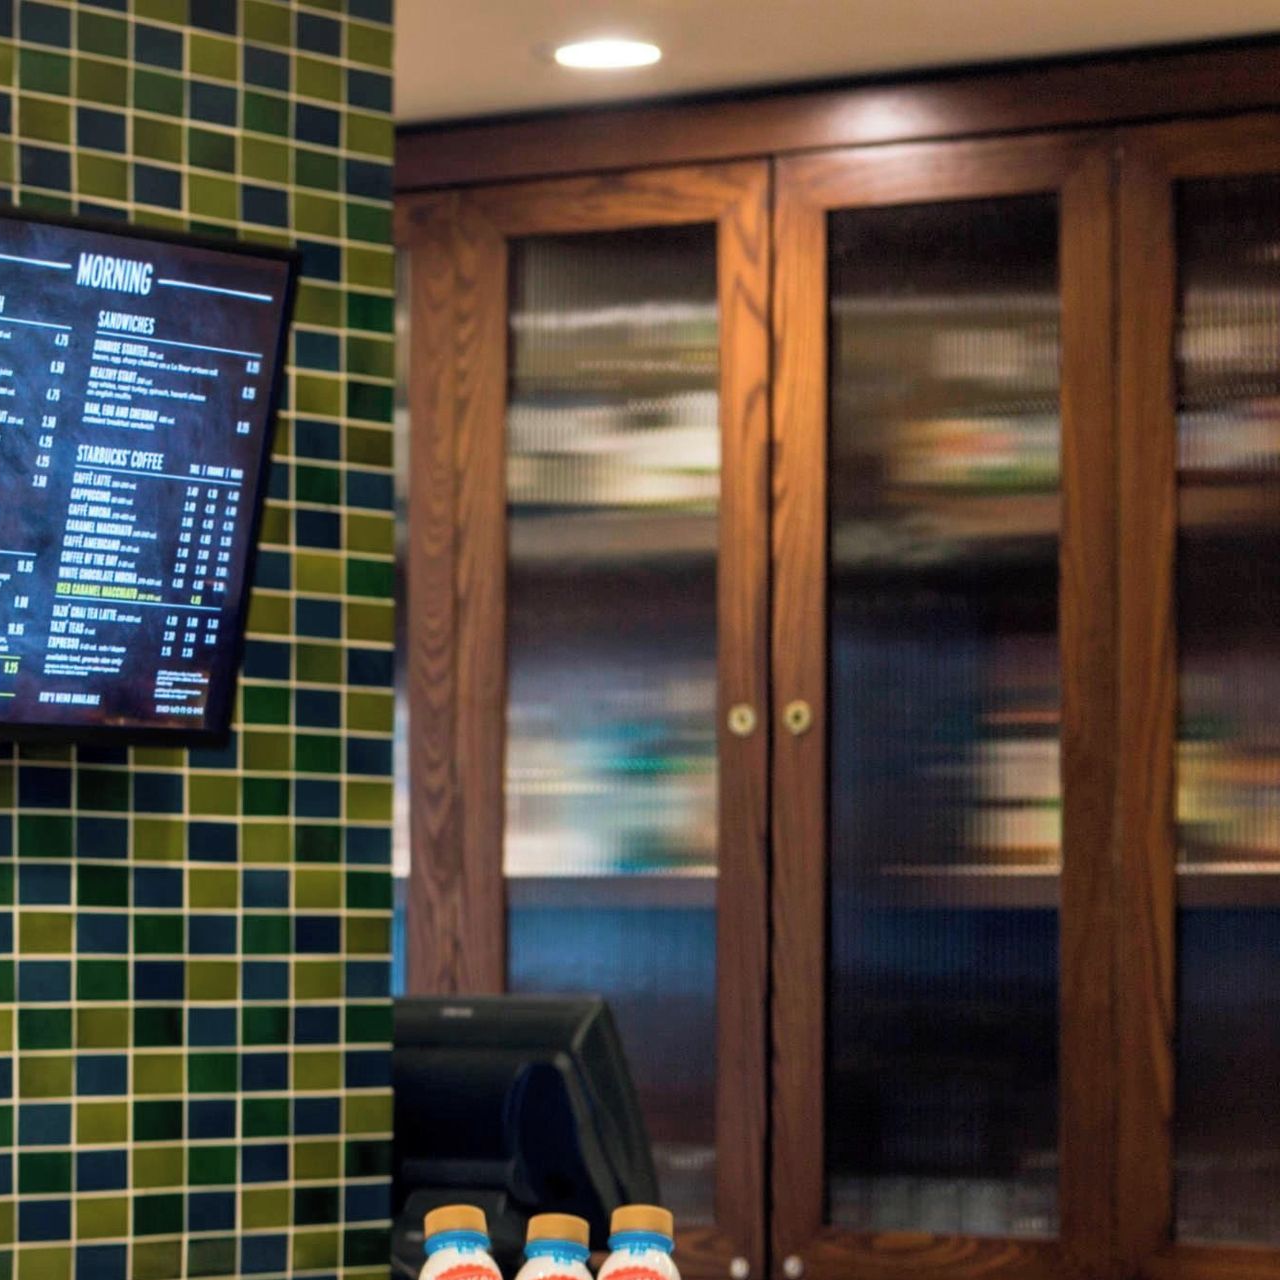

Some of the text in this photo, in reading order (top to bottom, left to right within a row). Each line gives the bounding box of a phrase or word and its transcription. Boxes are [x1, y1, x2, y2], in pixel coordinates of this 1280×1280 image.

[76, 253, 153, 295] MORNING
[98, 311, 154, 335] SANDWICHES
[94, 339, 121, 354] SUNRISE
[121, 343, 148, 357] STARTER
[89, 367, 118, 381] HEALTHY
[117, 370, 137, 383] START
[84, 402, 101, 416] HAM,
[101, 404, 115, 417] EGG
[115, 406, 129, 418] AND
[129, 408, 158, 422] CHEDDAR
[76, 445, 164, 470] STARBUCKS COFFEE
[93, 474, 111, 487] LATTE
[71, 488, 111, 503] CAPPUCCINO
[88, 506, 111, 518] MOCHA
[66, 519, 132, 536] CARAMEL MACCHIATO
[83, 537, 120, 551] AMERICANO
[61, 551, 118, 566] COFFEE OF THE DAY
[59, 567, 137, 584] WHITE CHOCOLATE MOCHA
[71, 606, 86, 618] CHAI
[87, 608, 98, 619] TEA
[99, 609, 117, 621] LATTE
[69, 622, 84, 634] TEAS
